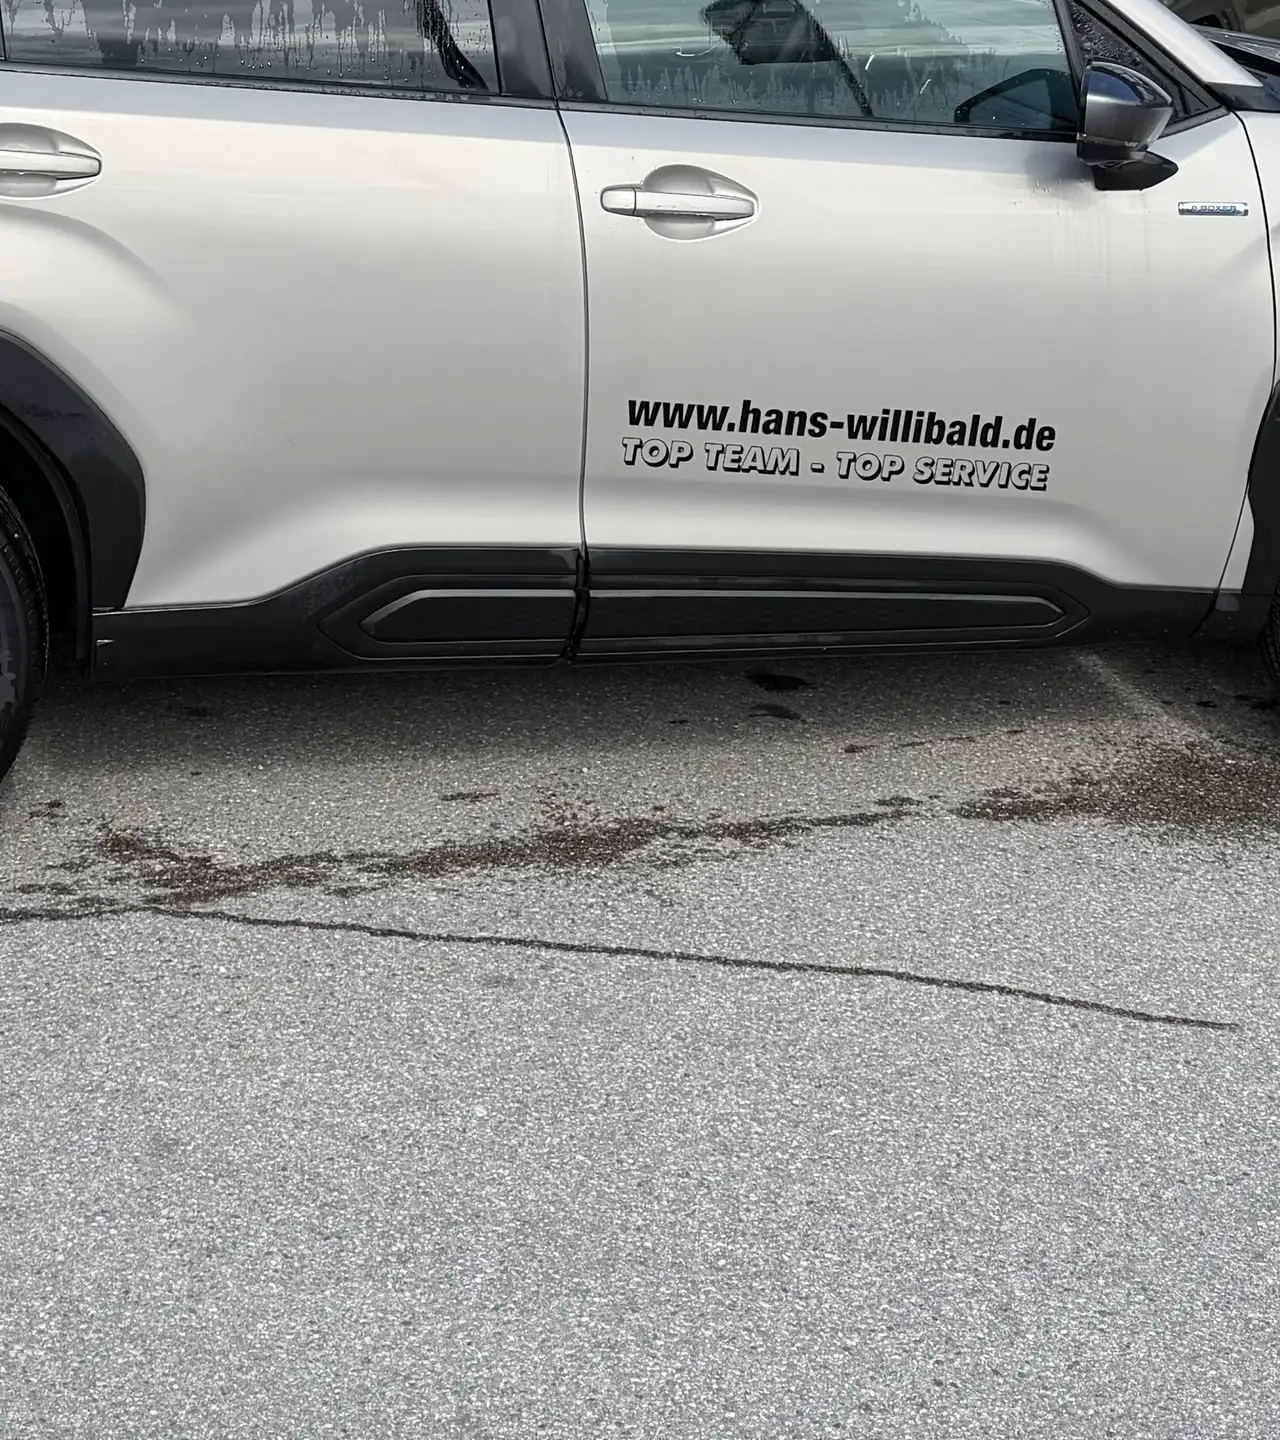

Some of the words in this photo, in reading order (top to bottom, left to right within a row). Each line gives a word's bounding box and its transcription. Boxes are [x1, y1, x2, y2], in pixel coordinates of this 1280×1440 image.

[627, 399, 1056, 452] www.hans-willibald.de
[622, 436, 693, 468] TOP
[704, 442, 800, 476] TEAM
[811, 462, 825, 474] -
[836, 451, 905, 482] TOP
[913, 456, 1050, 491] SERVICE
